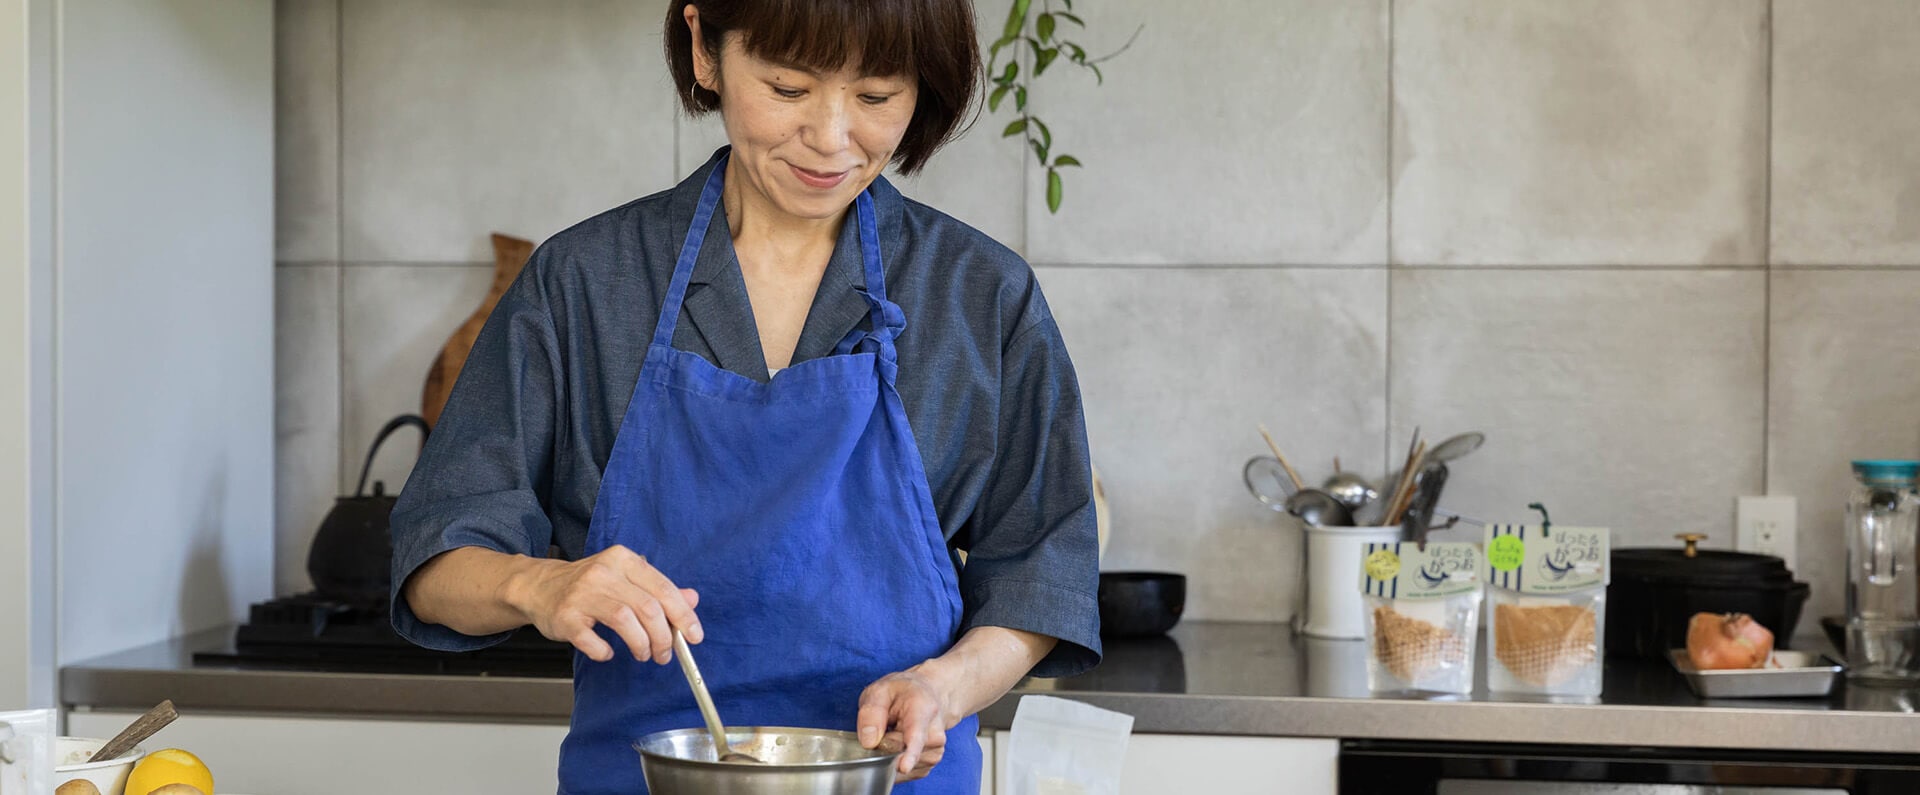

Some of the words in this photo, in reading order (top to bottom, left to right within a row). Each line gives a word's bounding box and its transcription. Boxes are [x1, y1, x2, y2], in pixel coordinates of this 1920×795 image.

[1554, 544, 1599, 563] がつお
[1430, 557, 1474, 574] がつお
